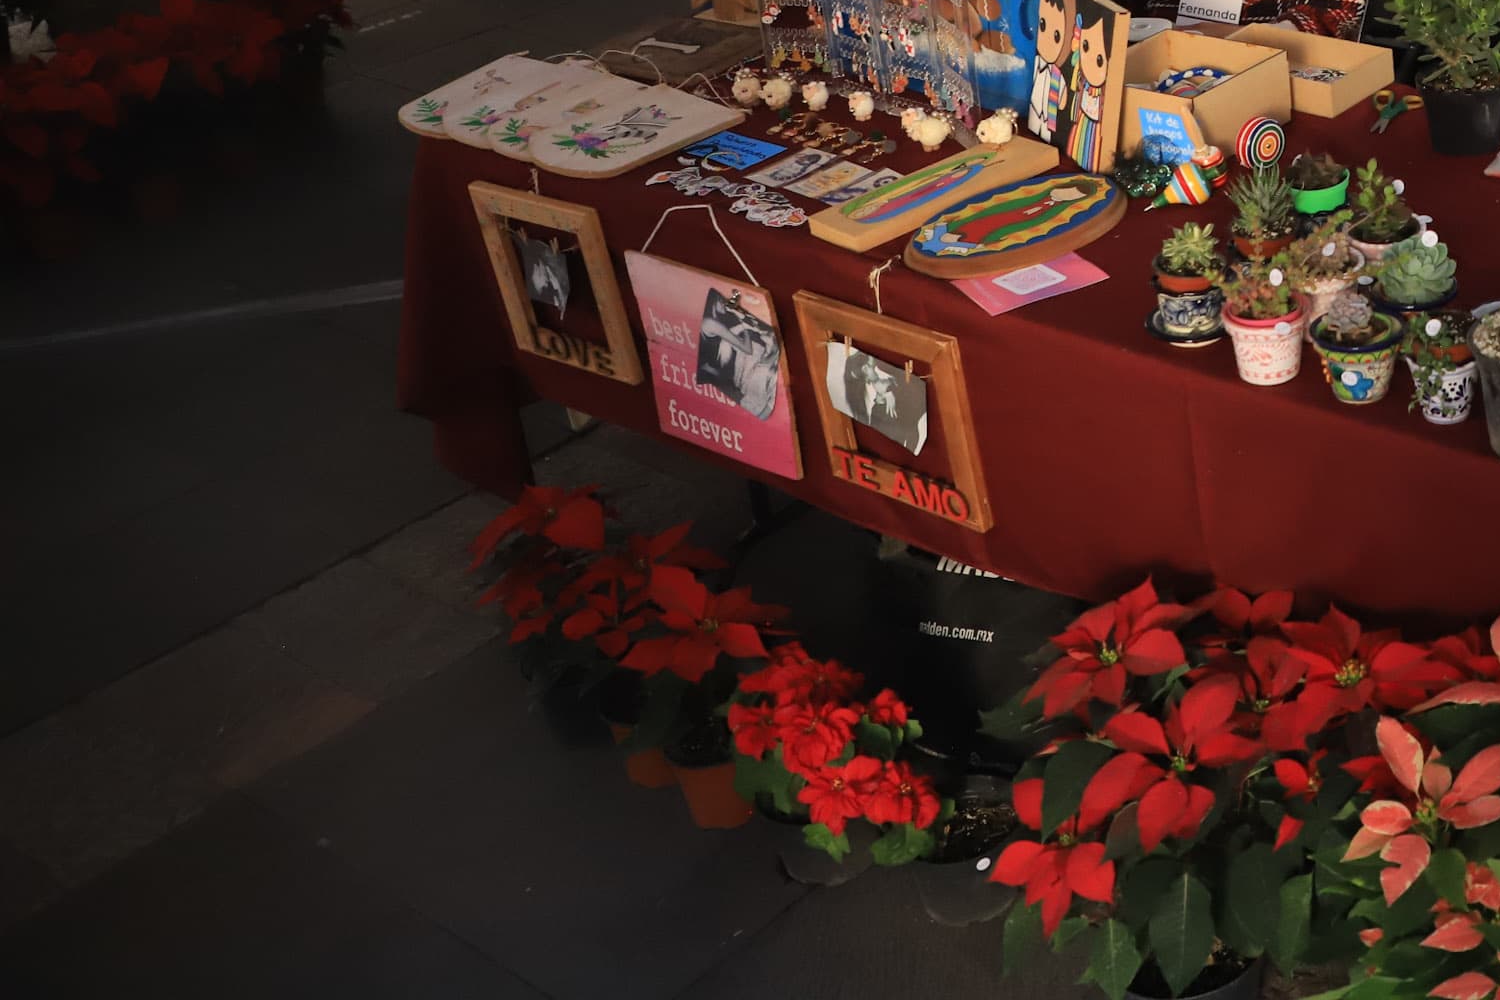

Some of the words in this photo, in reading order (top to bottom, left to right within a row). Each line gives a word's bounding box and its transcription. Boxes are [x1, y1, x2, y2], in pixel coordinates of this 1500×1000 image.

[1179, 2, 1237, 21] Fernanda
[1145, 111, 1162, 124] Kit
[528, 322, 615, 376] LOVE
[648, 307, 697, 349] best
[668, 398, 743, 453] forever
[831, 447, 880, 490] TE
[892, 470, 969, 522] AMO
